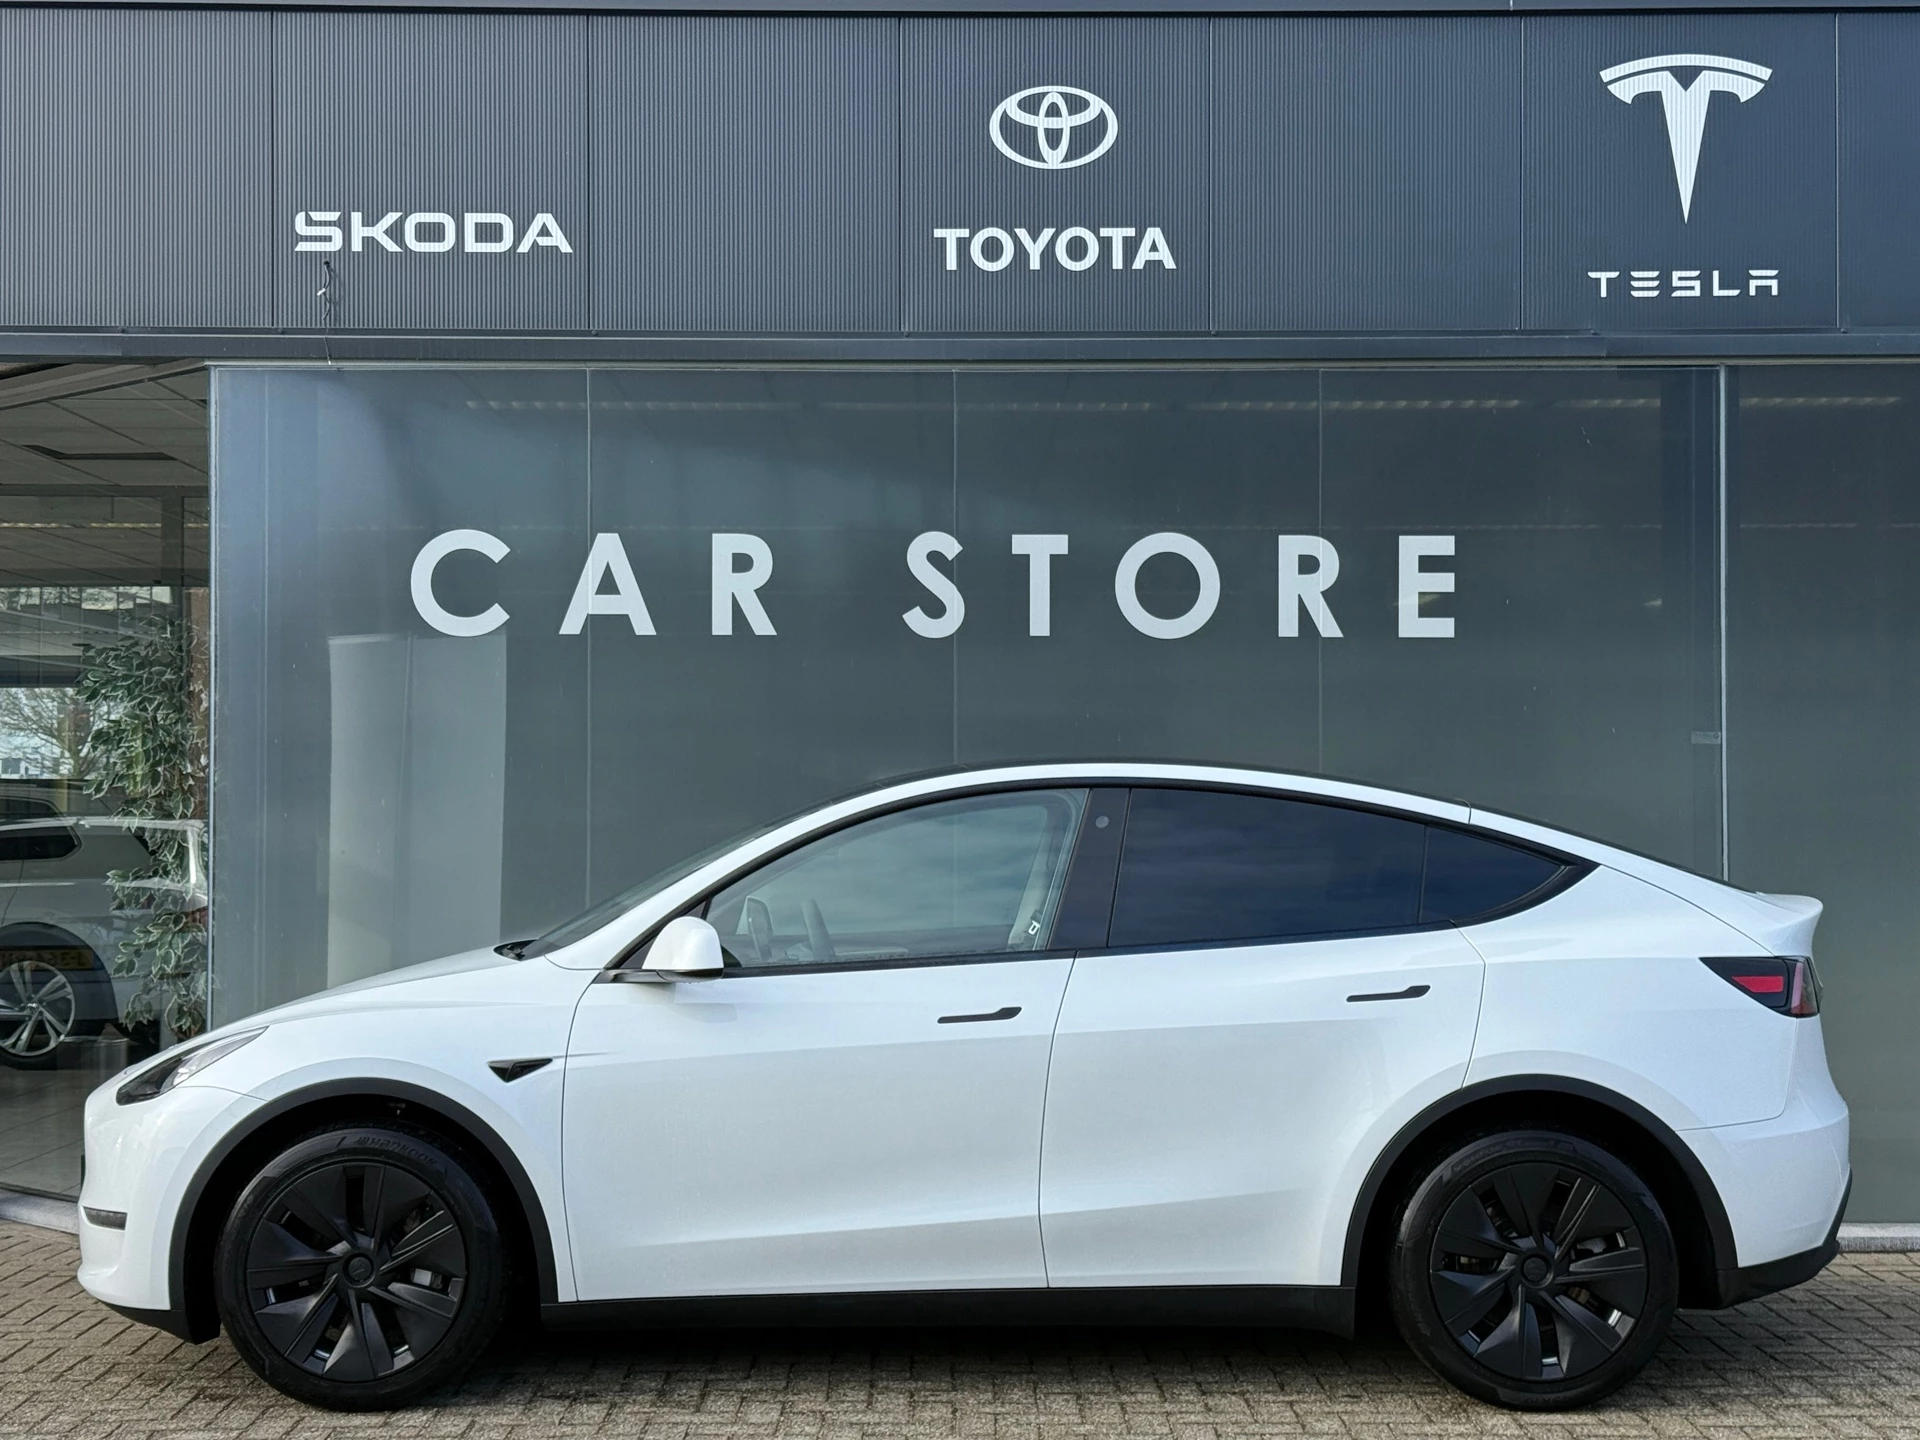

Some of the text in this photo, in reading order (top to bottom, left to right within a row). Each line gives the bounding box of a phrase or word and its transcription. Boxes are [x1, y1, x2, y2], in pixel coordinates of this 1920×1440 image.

[933, 227, 1177, 272] TOYOTA
[1587, 269, 1779, 298] TESLA
[410, 529, 1456, 640] CAR STORE
